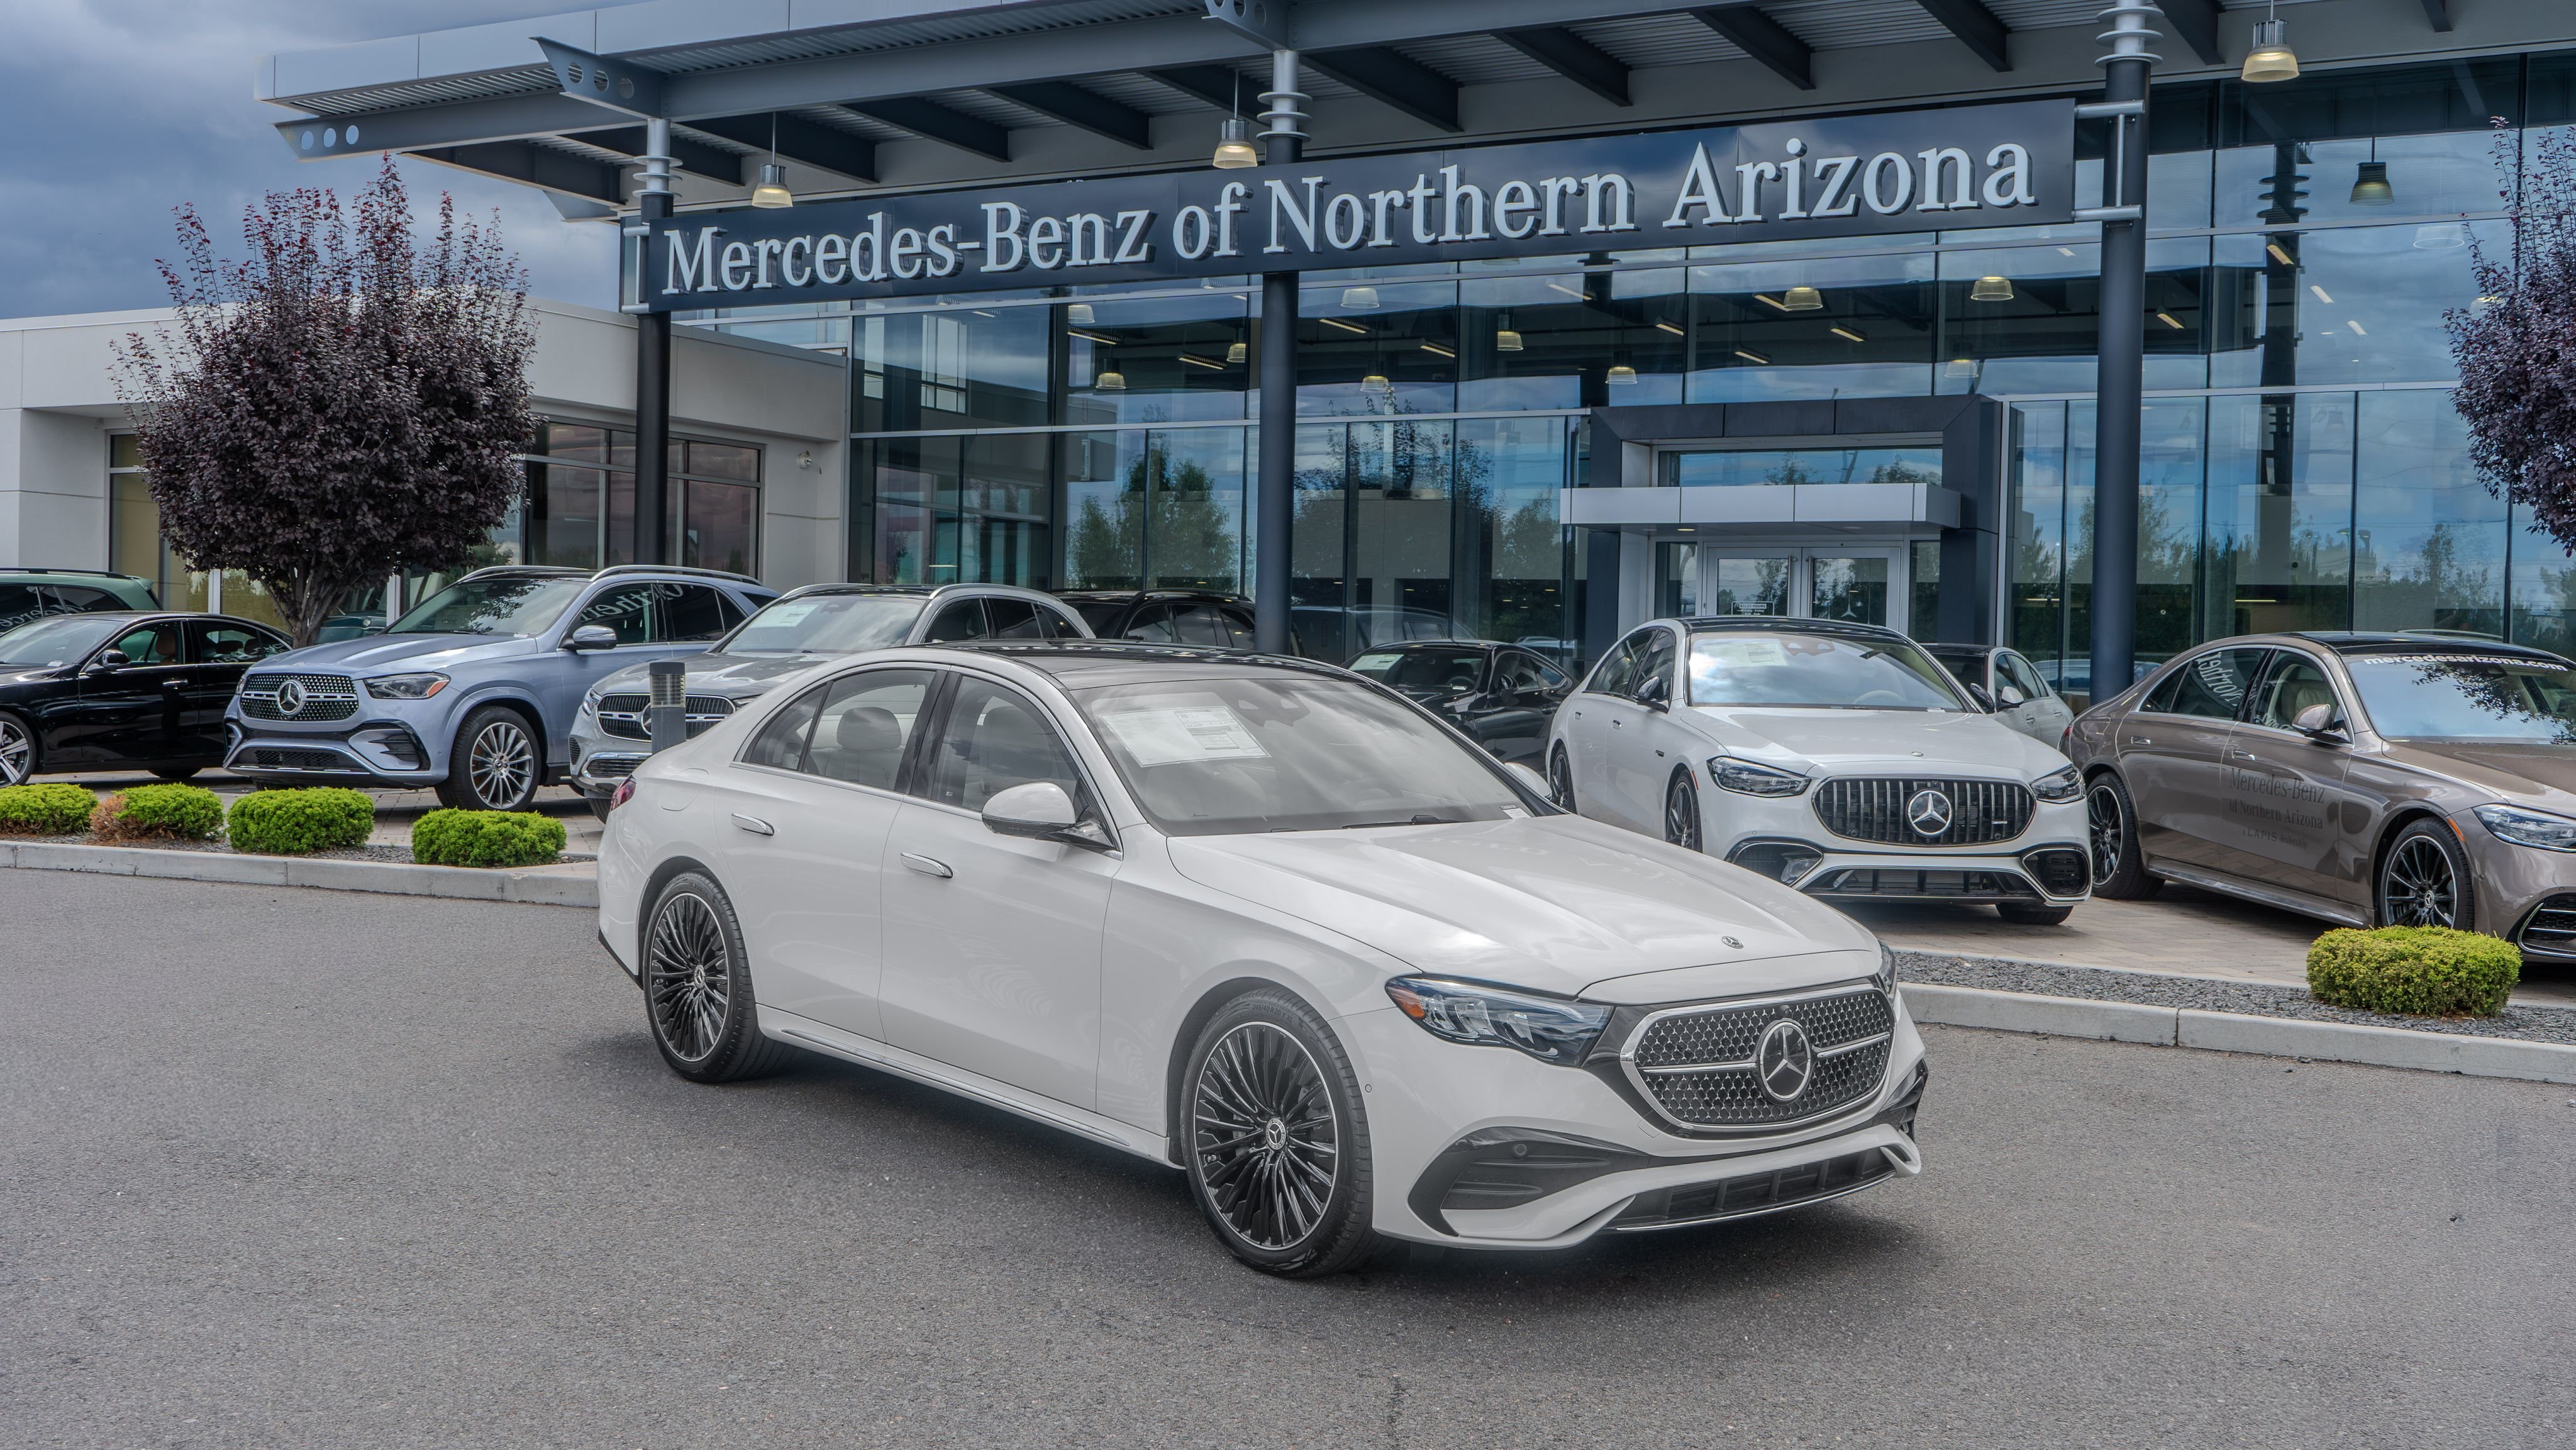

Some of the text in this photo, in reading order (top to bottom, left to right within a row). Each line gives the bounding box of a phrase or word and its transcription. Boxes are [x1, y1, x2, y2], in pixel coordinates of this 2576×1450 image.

[662, 137, 2036, 294] Mercedes-Benz of Northern Arizona
[2363, 654, 2568, 672] mercedesarizona.com
[2229, 767, 2326, 804] Mercedes-Benz
[2229, 798, 2323, 830] of Northern Arizona
[2247, 827, 2278, 842] LAPIS
[2279, 834, 2308, 850] dealership
